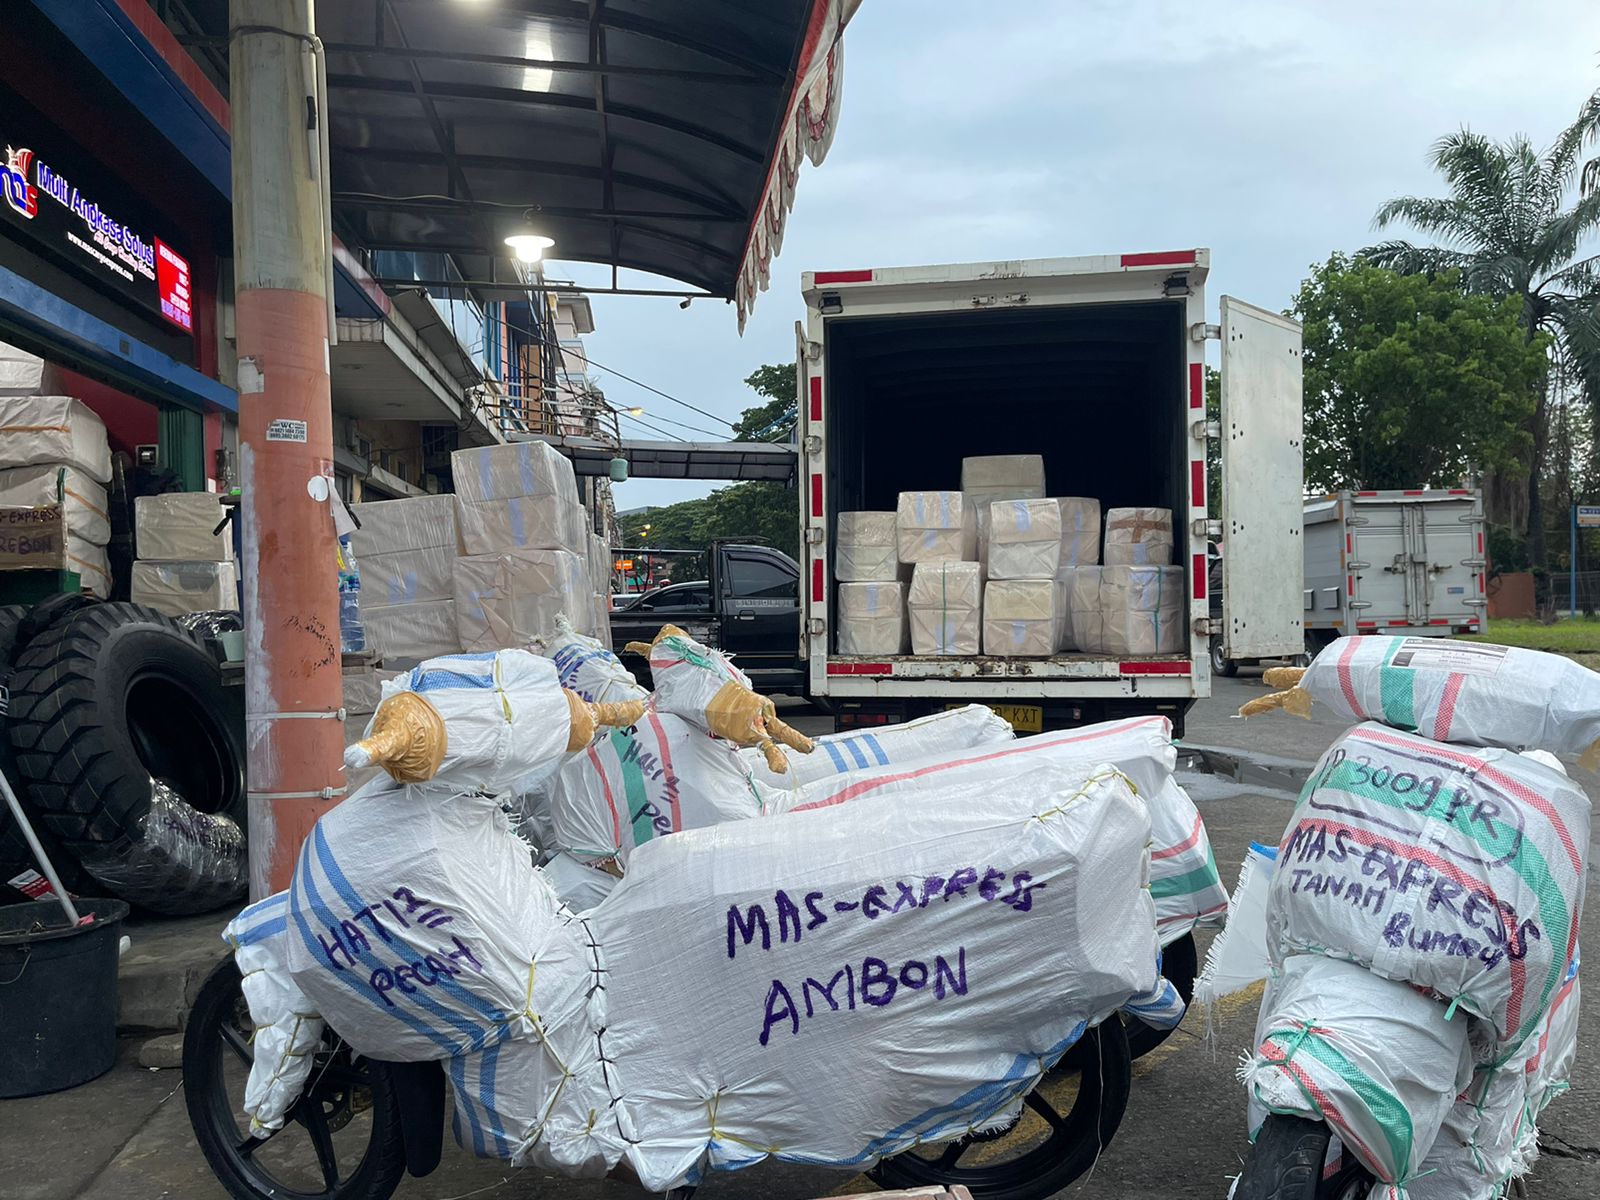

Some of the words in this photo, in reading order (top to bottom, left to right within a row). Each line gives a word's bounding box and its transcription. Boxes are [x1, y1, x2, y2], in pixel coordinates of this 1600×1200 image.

[36, 160, 68, 208] Multi
[71, 188, 123, 244] Angkasa
[123, 226, 155, 269] Solusi
[1012, 707, 1038, 723] KXT
[1291, 868, 1388, 915] TANAH
[759, 947, 969, 1047] AMBON
